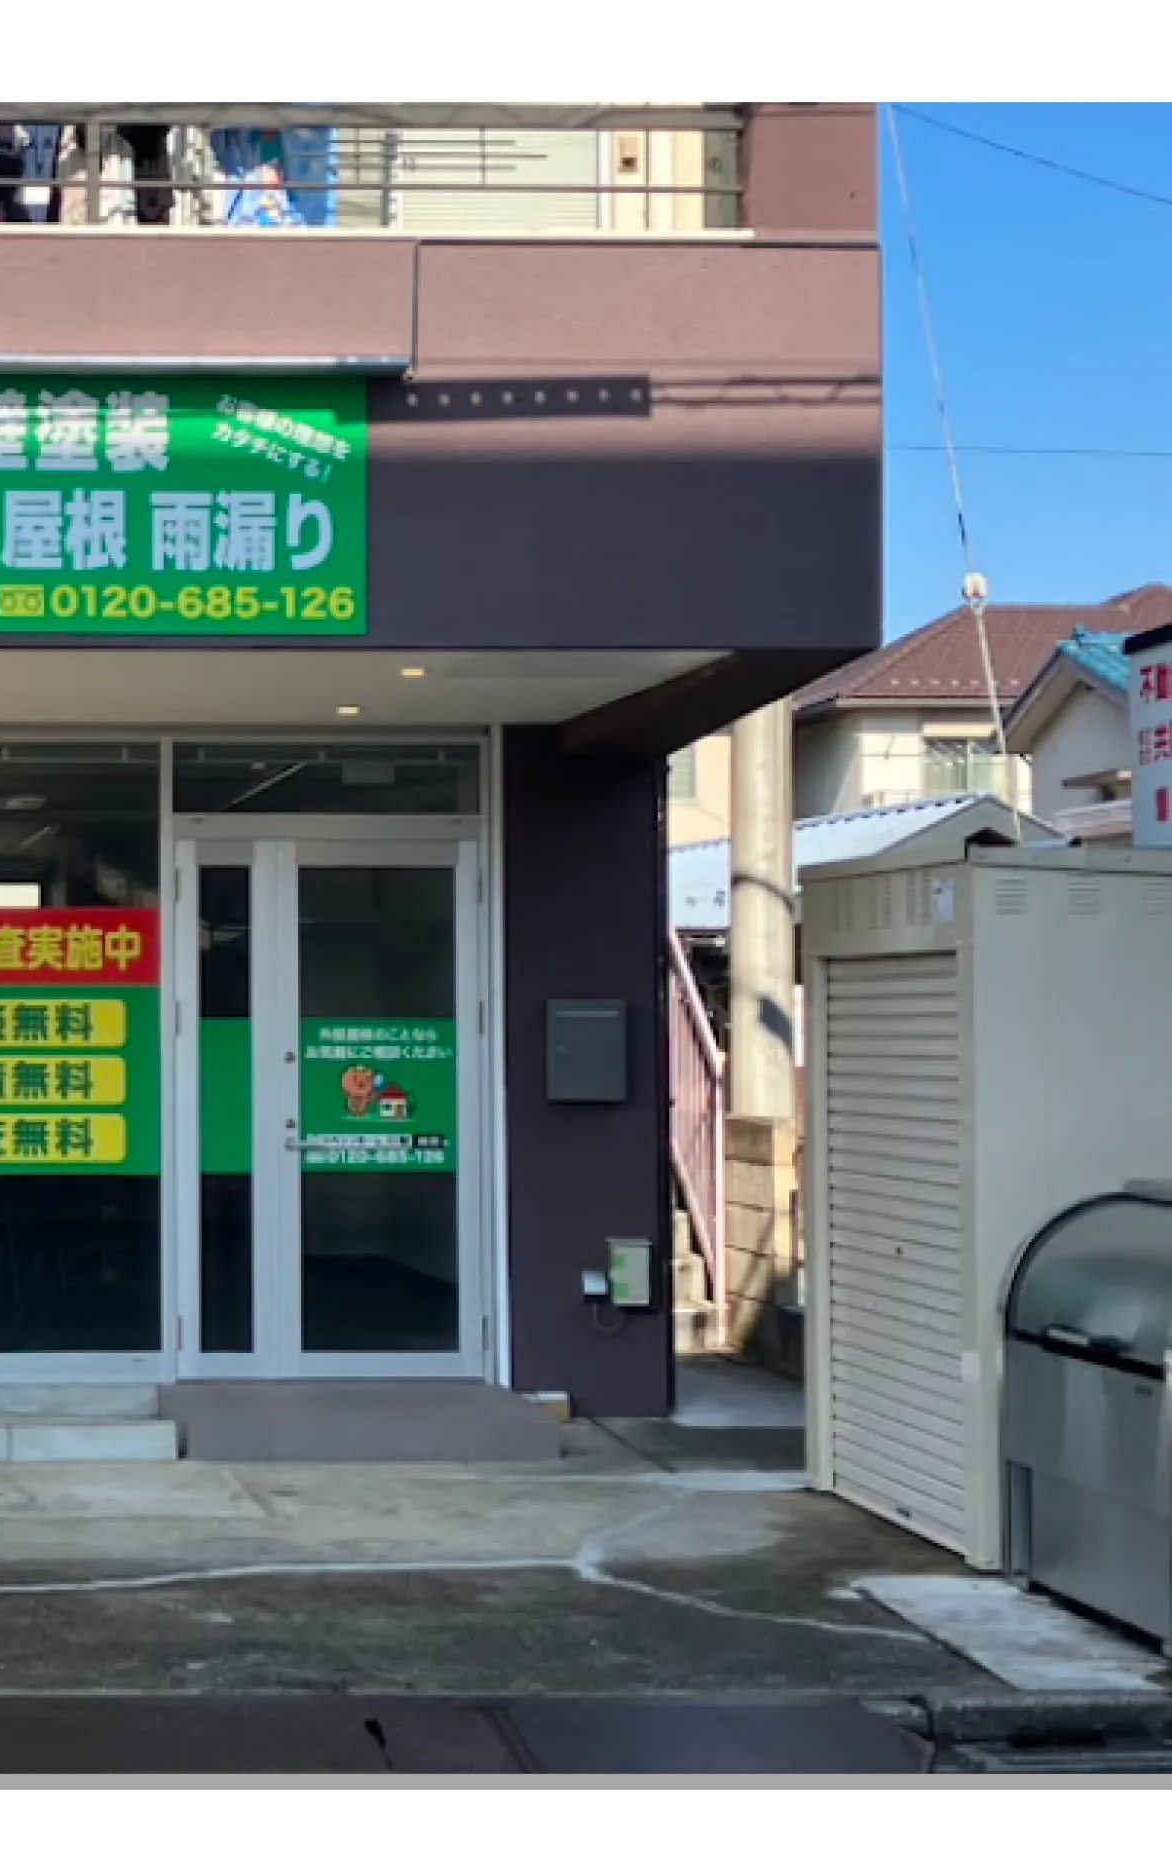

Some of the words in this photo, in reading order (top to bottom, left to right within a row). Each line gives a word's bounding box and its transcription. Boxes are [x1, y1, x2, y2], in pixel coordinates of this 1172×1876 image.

[1, 489, 127, 571] 屋根
[150, 488, 334, 571] 雨漏り
[50, 586, 355, 620] 0120-685-126
